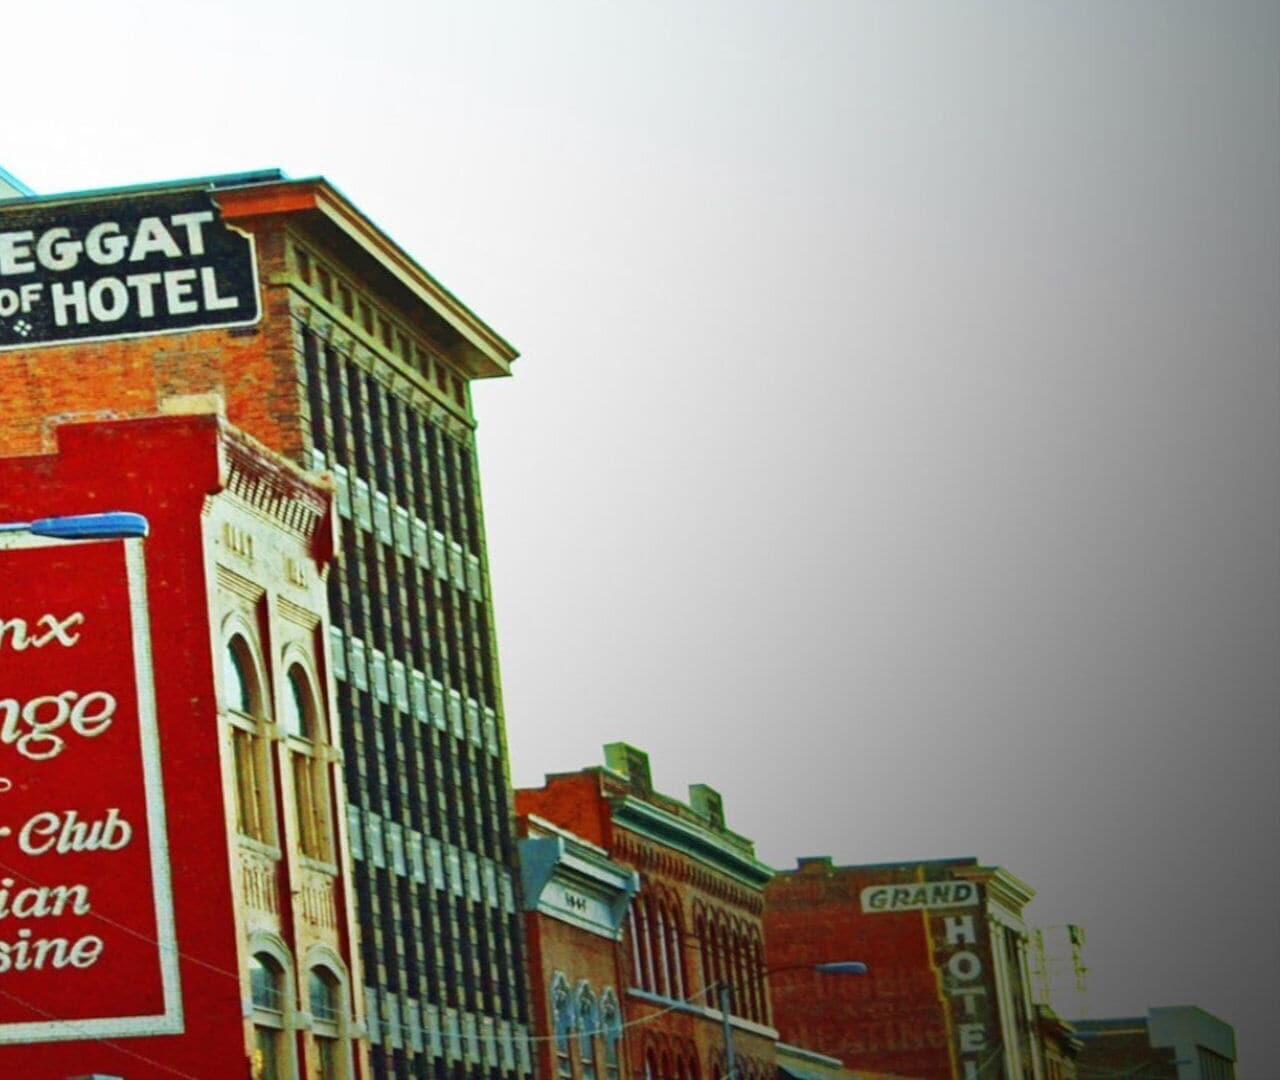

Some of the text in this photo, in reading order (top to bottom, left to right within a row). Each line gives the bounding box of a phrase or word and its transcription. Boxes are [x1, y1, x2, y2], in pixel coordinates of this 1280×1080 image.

[52, 267, 239, 327] HOTEL
[18, 808, 131, 855] Club
[869, 885, 972, 909] GRAND
